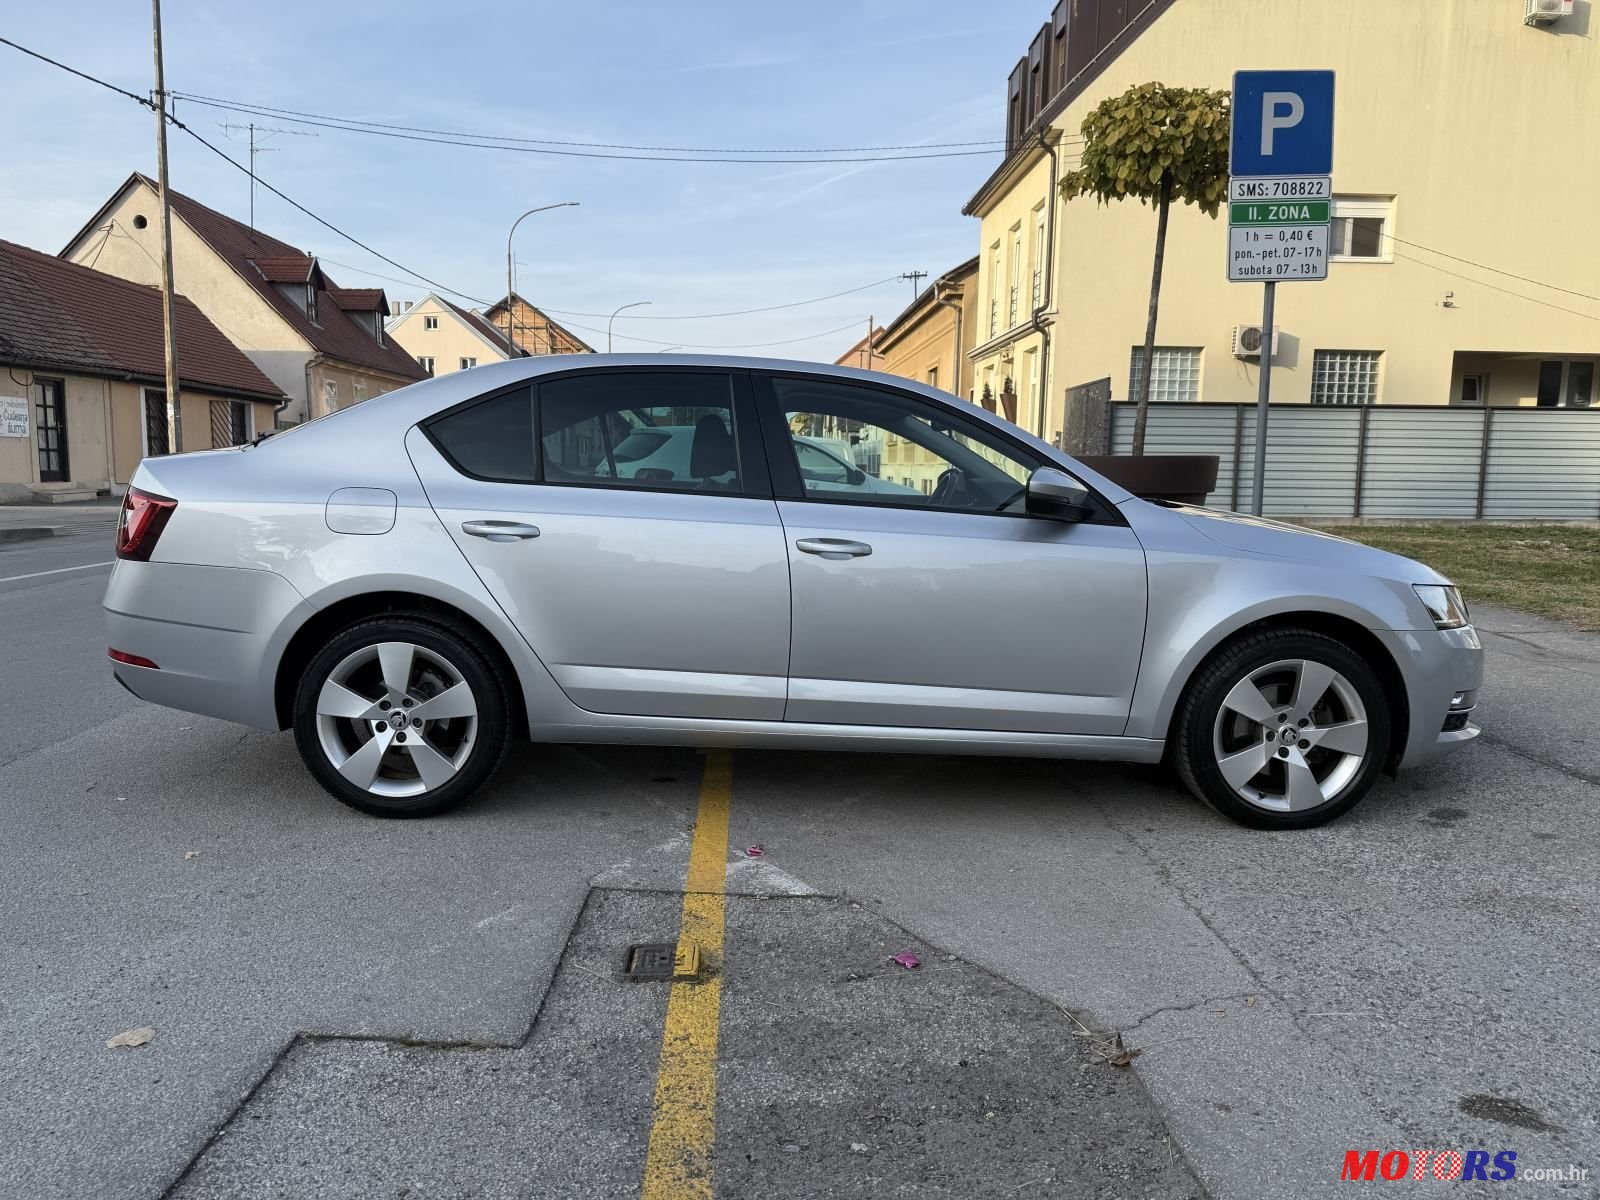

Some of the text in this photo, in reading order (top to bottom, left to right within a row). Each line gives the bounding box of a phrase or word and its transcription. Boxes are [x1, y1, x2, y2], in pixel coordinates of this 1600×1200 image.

[1260, 91, 1305, 156] P
[1238, 181, 1323, 197] SMS: 708822
[1248, 205, 1310, 220] II. ZONA
[1253, 231, 1259, 242] h
[1279, 230, 1303, 243] 0,40
[1307, 230, 1313, 241] €
[1235, 247, 1280, 261] pon.-pet.
[1238, 264, 1272, 275] subota
